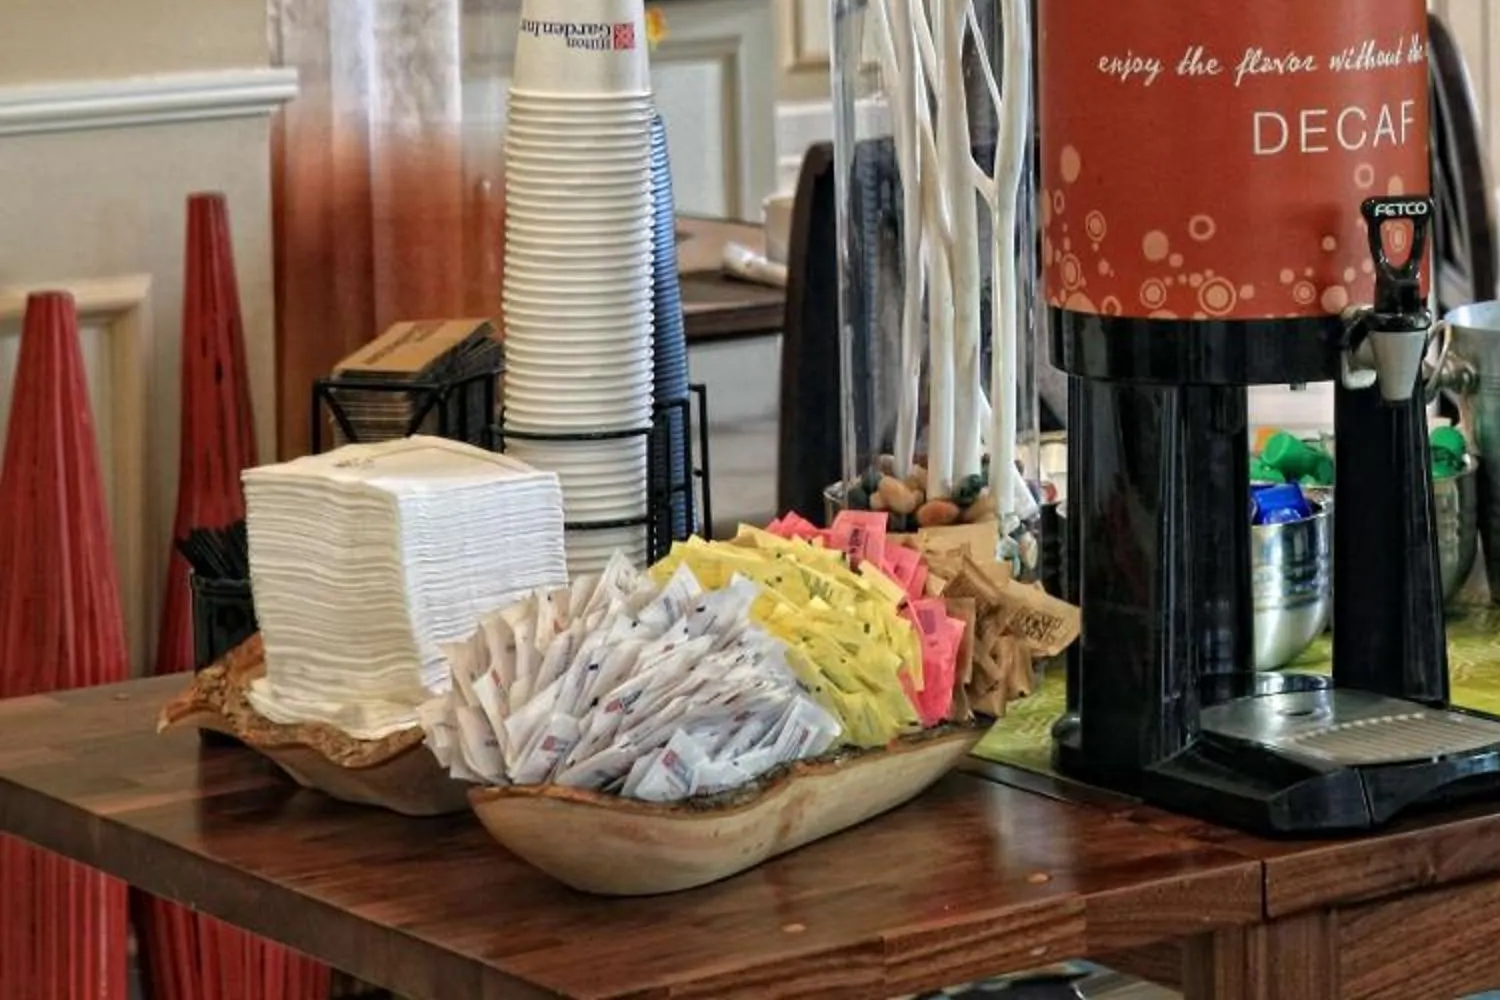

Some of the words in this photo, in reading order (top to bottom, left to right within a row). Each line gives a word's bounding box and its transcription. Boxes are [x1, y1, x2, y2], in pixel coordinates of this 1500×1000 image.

[543, 22, 611, 38] Garden
[567, 37, 611, 51] Hilton
[1097, 48, 1163, 87] enjoy
[1176, 44, 1222, 77] the
[1235, 46, 1318, 88] flavor
[1328, 37, 1404, 73] without
[1252, 99, 1416, 156] DECAF
[1374, 201, 1428, 217] FETCO
